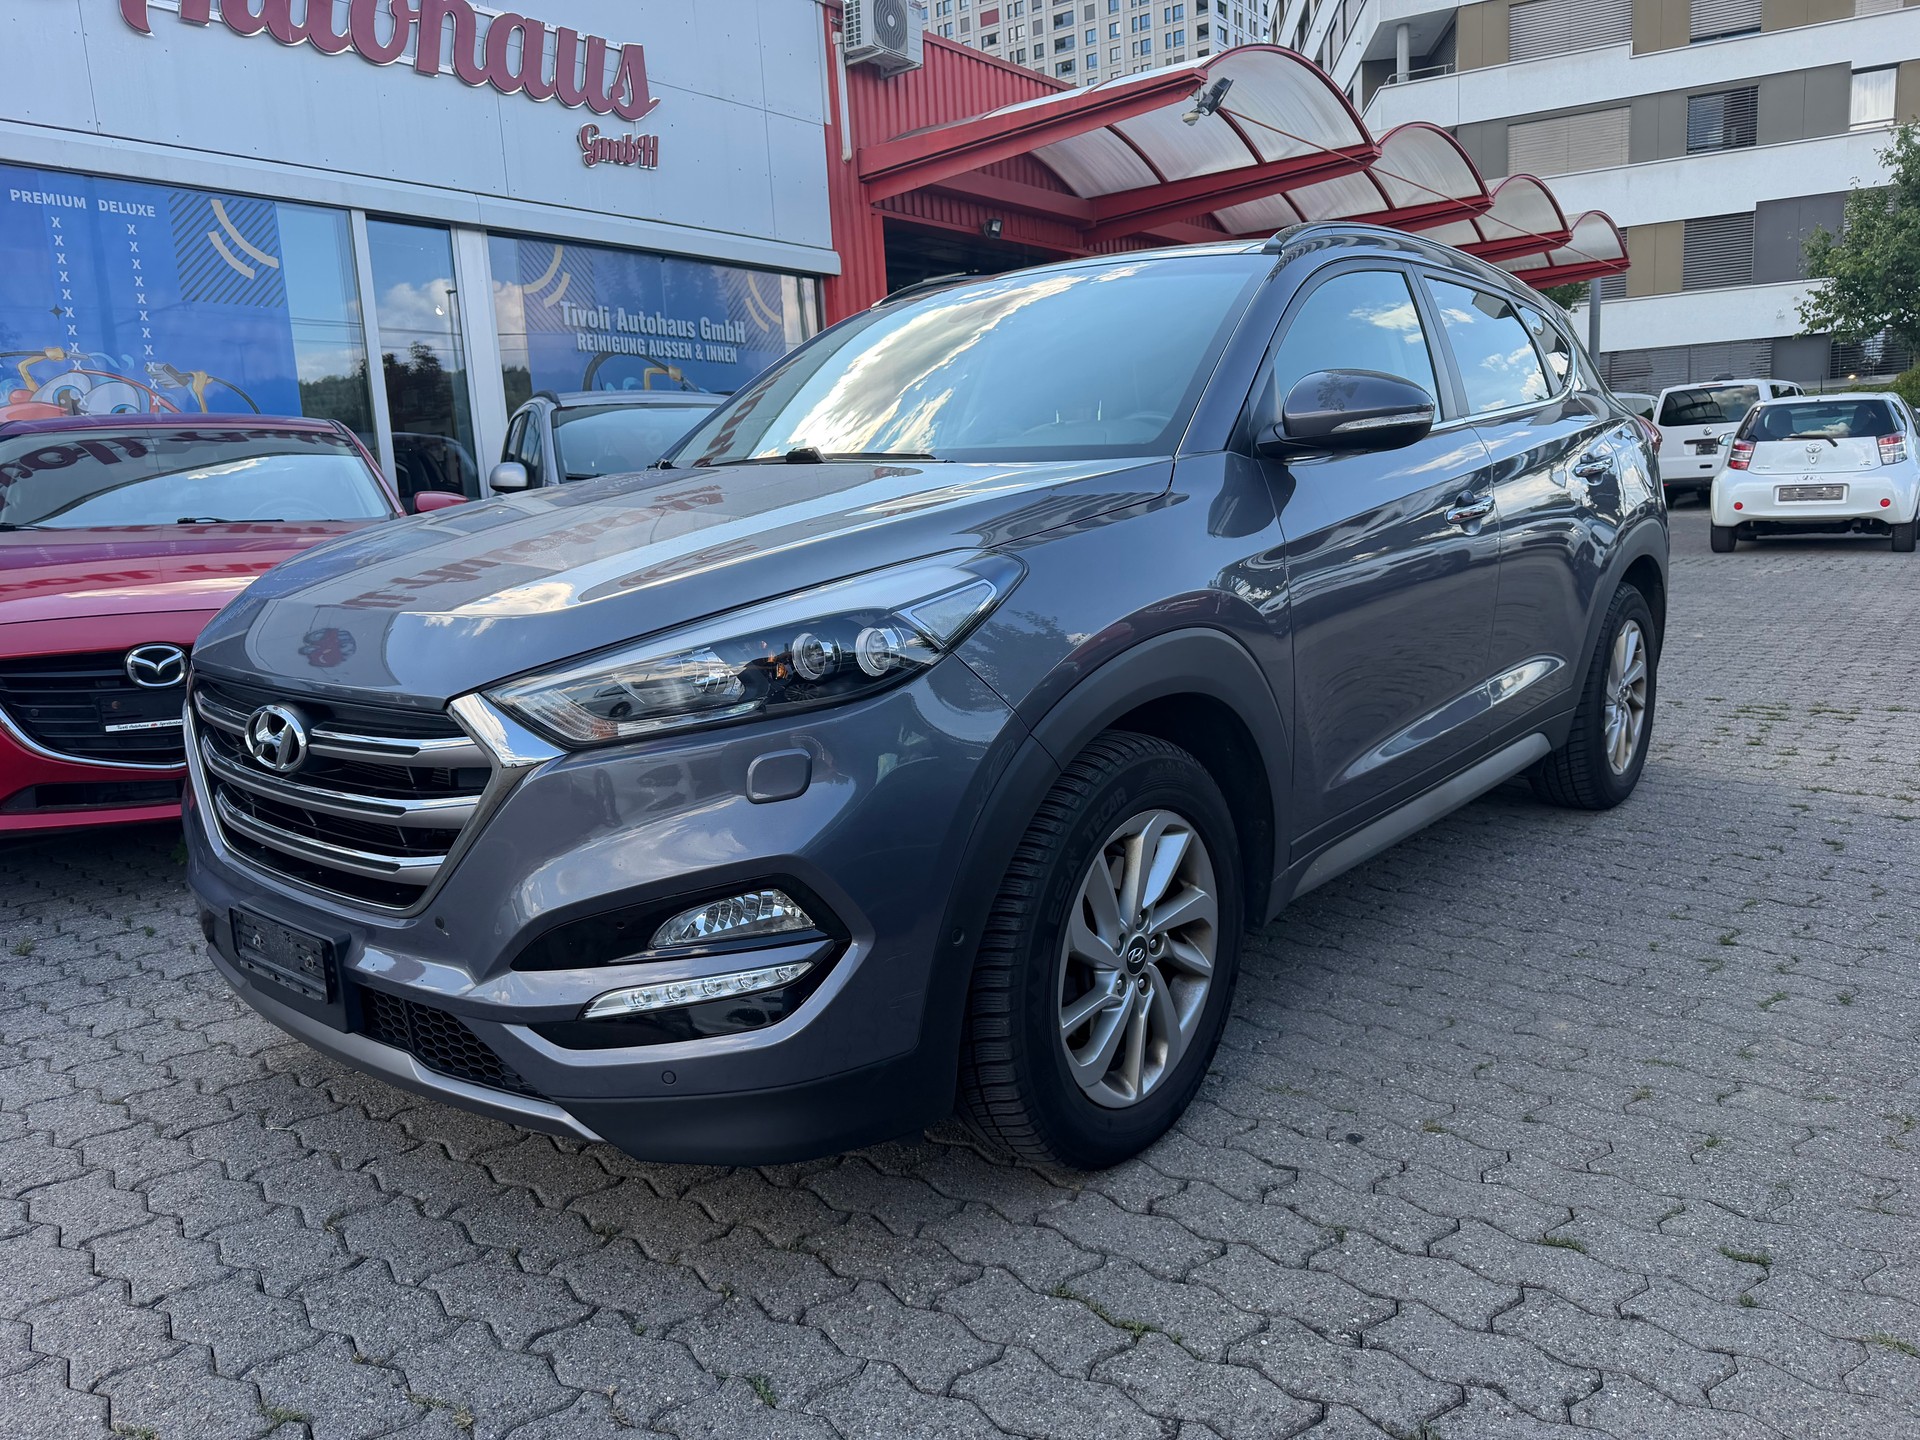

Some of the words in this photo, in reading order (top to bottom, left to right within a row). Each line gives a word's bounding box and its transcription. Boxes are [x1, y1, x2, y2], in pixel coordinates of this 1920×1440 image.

[119, 0, 661, 122] ohaus
[577, 123, 659, 170] GmbH
[9, 189, 87, 209] PREMIUM
[98, 199, 156, 217] DELUXE
[559, 300, 611, 331] Tivoli
[617, 307, 696, 339] Autohaus
[700, 316, 746, 344] GmbH
[576, 332, 646, 356] REINIGUNG
[649, 339, 692, 360] AUSSEN
[695, 345, 704, 360] &
[706, 345, 738, 364] INNEN
